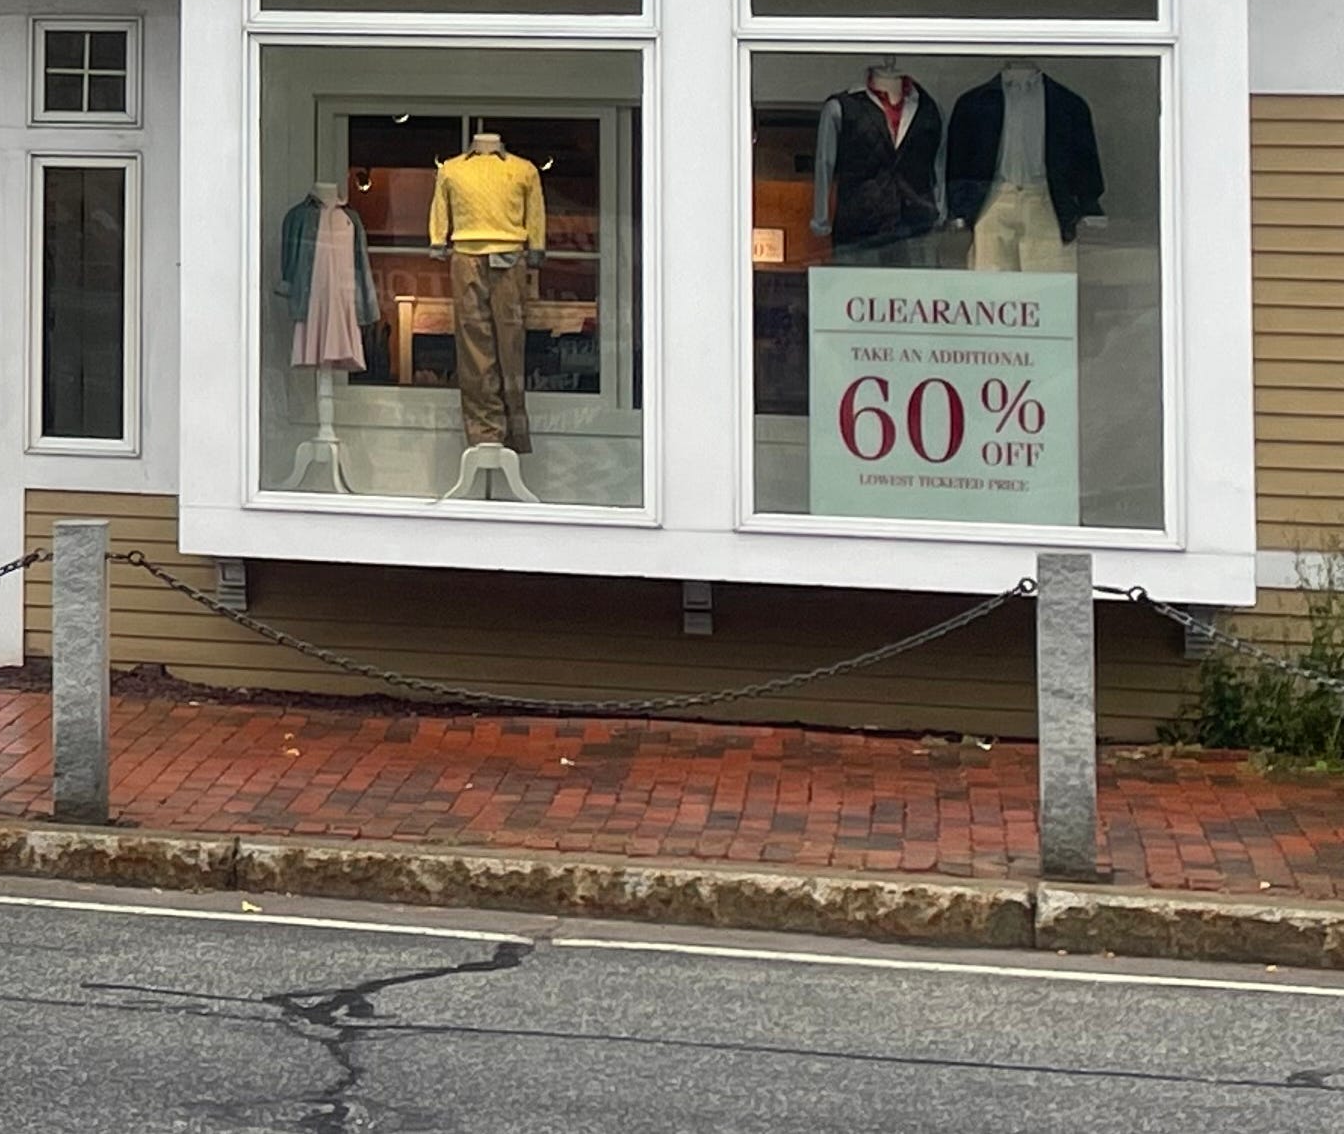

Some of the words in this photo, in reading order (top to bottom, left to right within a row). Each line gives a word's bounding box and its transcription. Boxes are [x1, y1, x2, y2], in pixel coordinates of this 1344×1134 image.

[846, 296, 1041, 328] CLEARANCE
[851, 346, 894, 362] TAKE
[898, 348, 923, 363] AN
[927, 349, 1035, 367] ADDITIONAL
[838, 375, 1046, 464] 60%
[981, 441, 1045, 468] OFF
